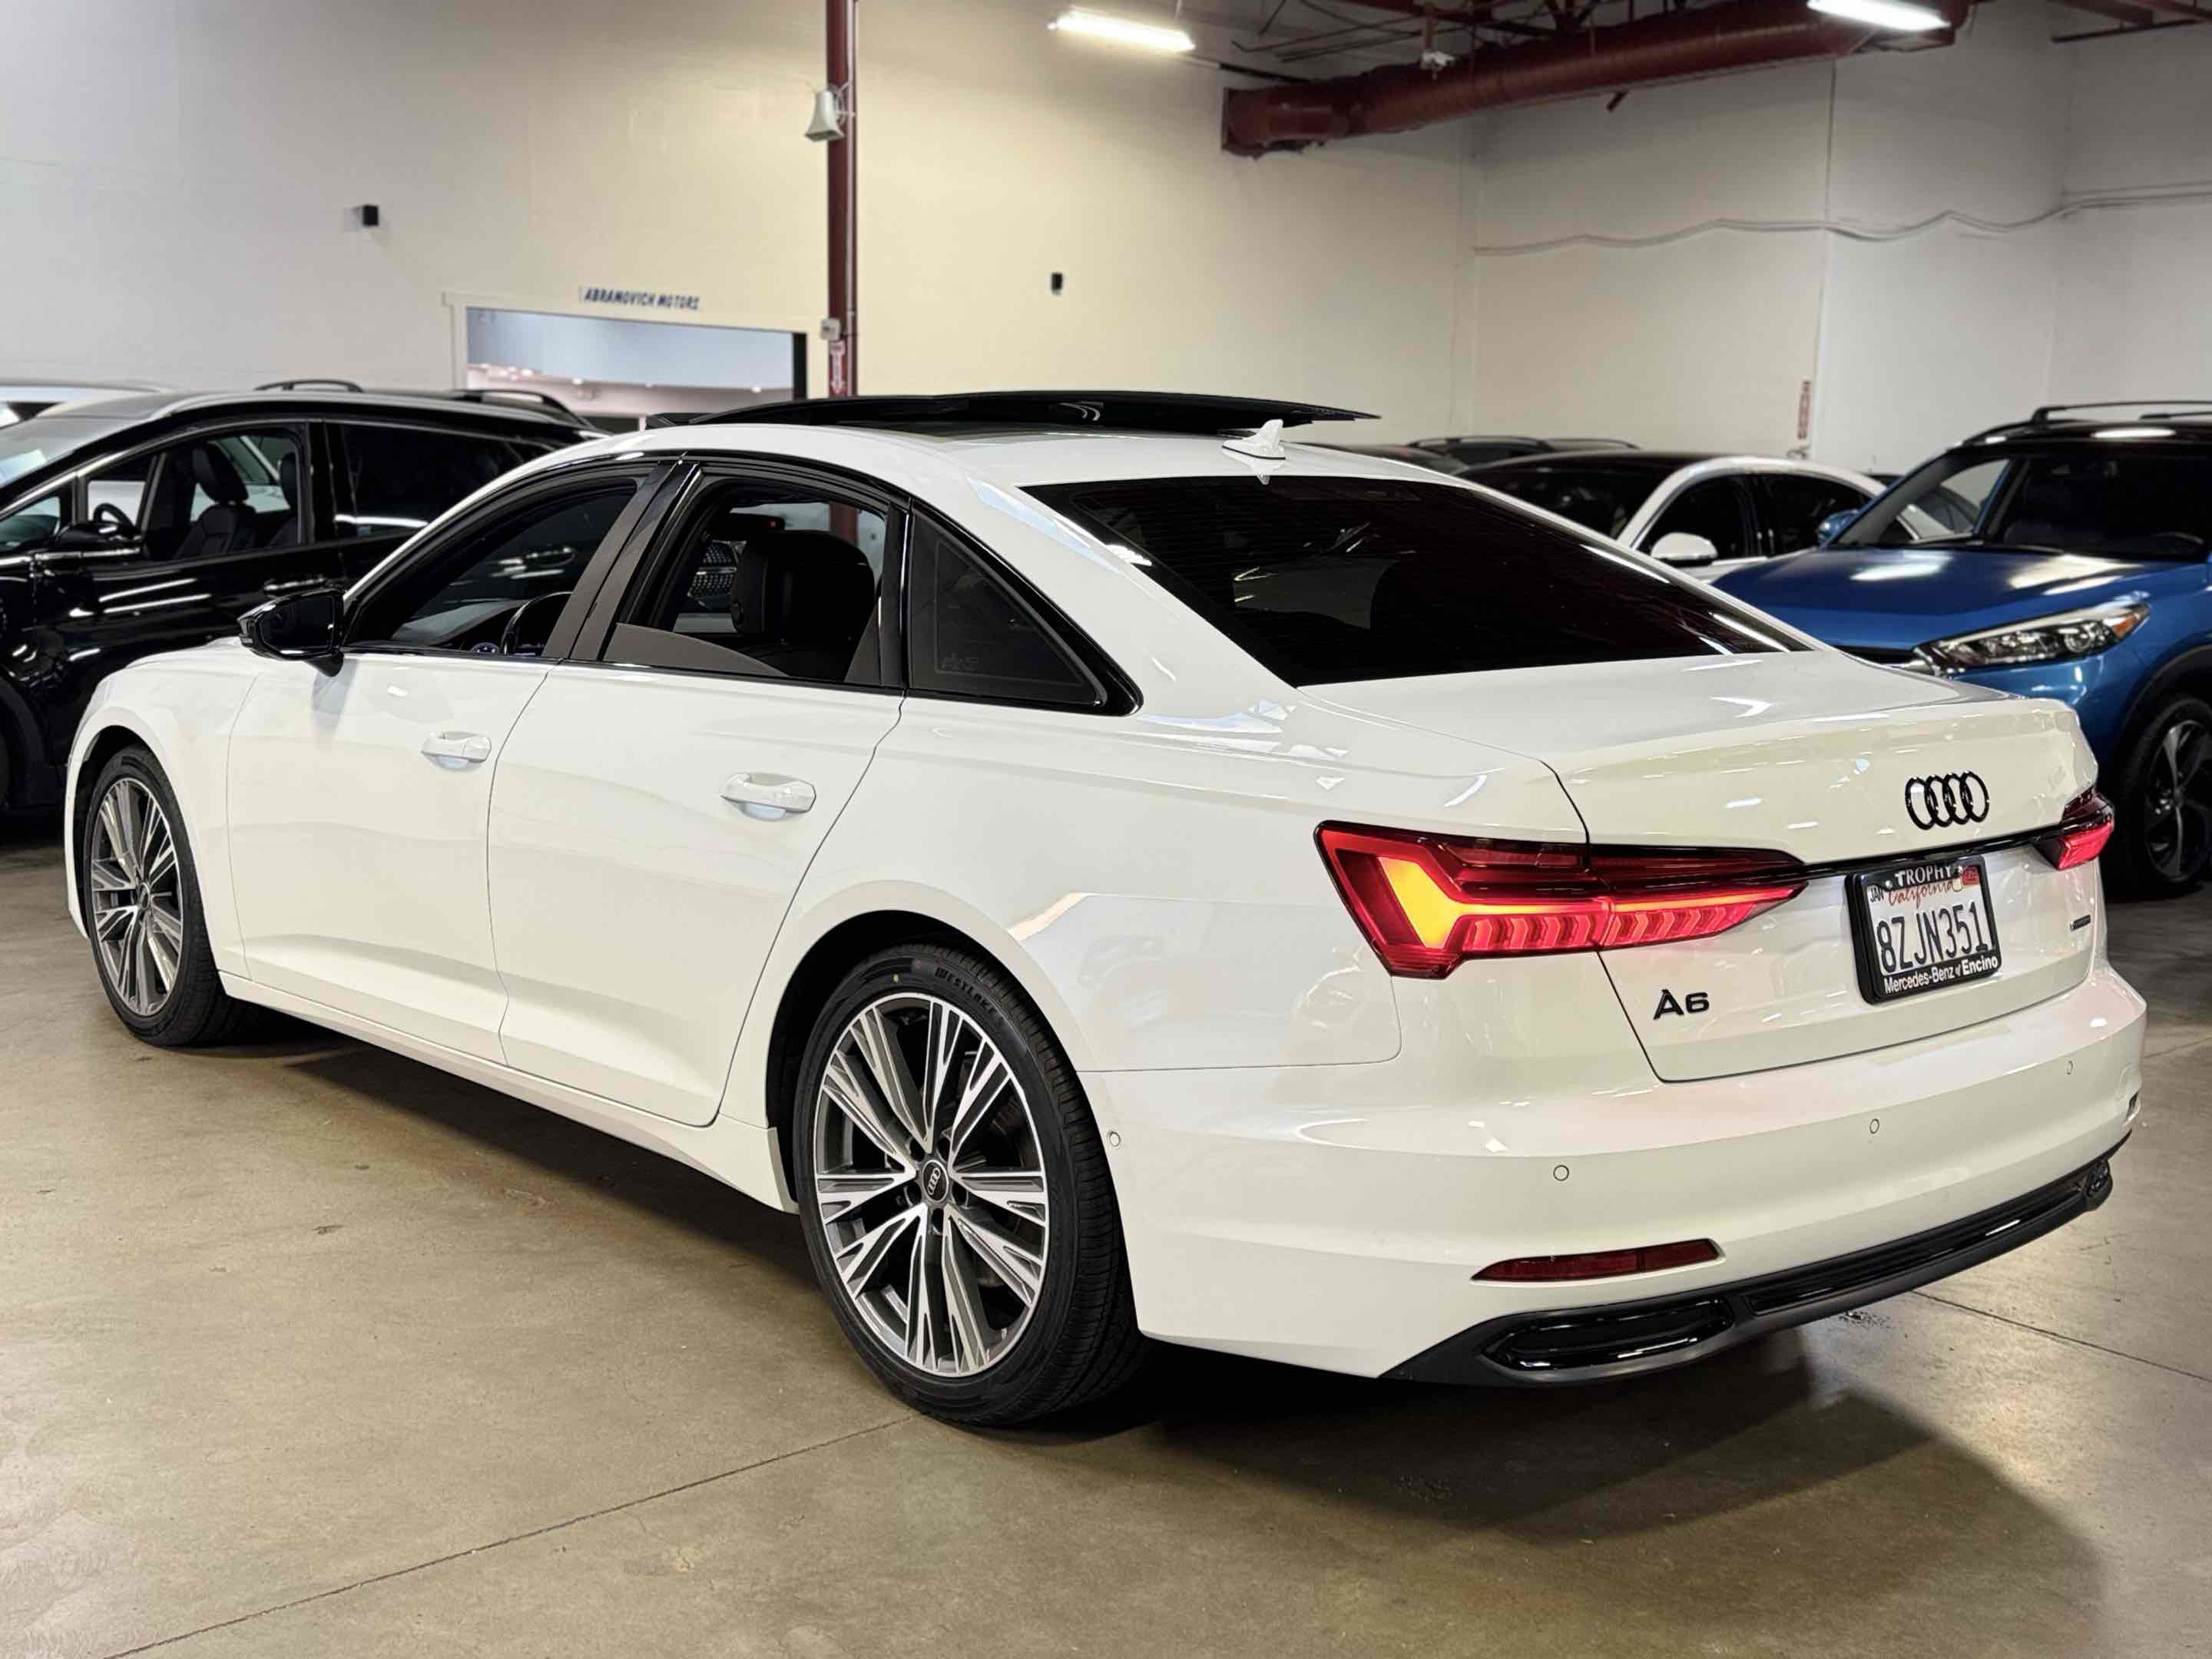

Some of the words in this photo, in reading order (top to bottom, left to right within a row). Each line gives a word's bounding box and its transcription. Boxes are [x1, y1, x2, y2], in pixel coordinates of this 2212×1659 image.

[584, 288, 655, 306] ABRAMOVICH
[657, 295, 700, 310] MOTORS
[1894, 866, 1952, 887] TROPHY
[1876, 901, 1988, 974] 8ZJN351
[1884, 966, 1955, 995] Mercedes-Benz
[1961, 955, 1998, 975] Encino
[1653, 988, 1710, 1020] A6
